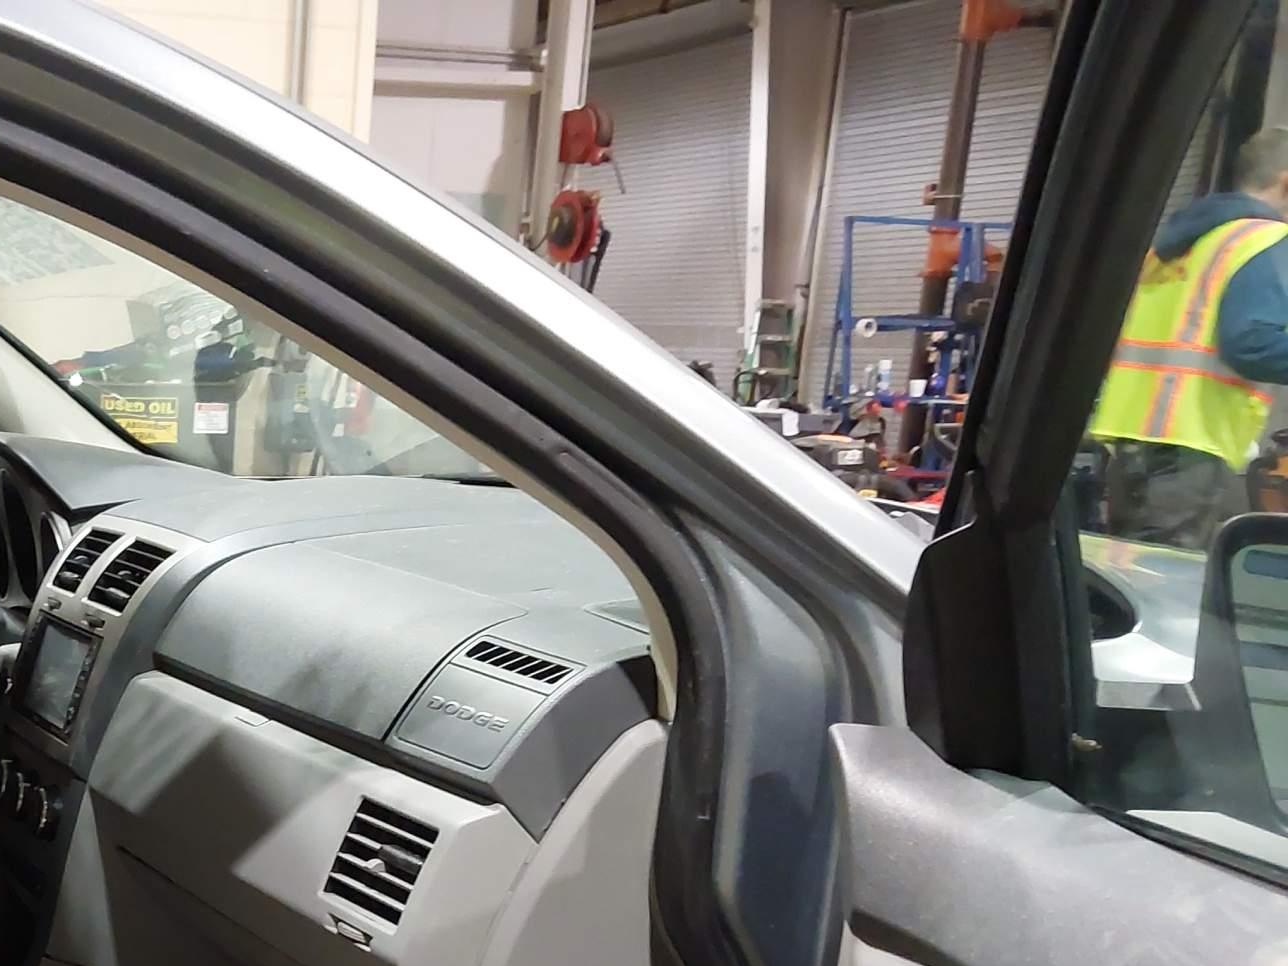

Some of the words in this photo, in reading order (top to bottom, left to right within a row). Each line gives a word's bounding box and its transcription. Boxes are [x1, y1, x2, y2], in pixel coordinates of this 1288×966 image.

[104, 399, 145, 413] USED
[148, 401, 176, 415] OIL
[427, 695, 510, 733] DODGE
